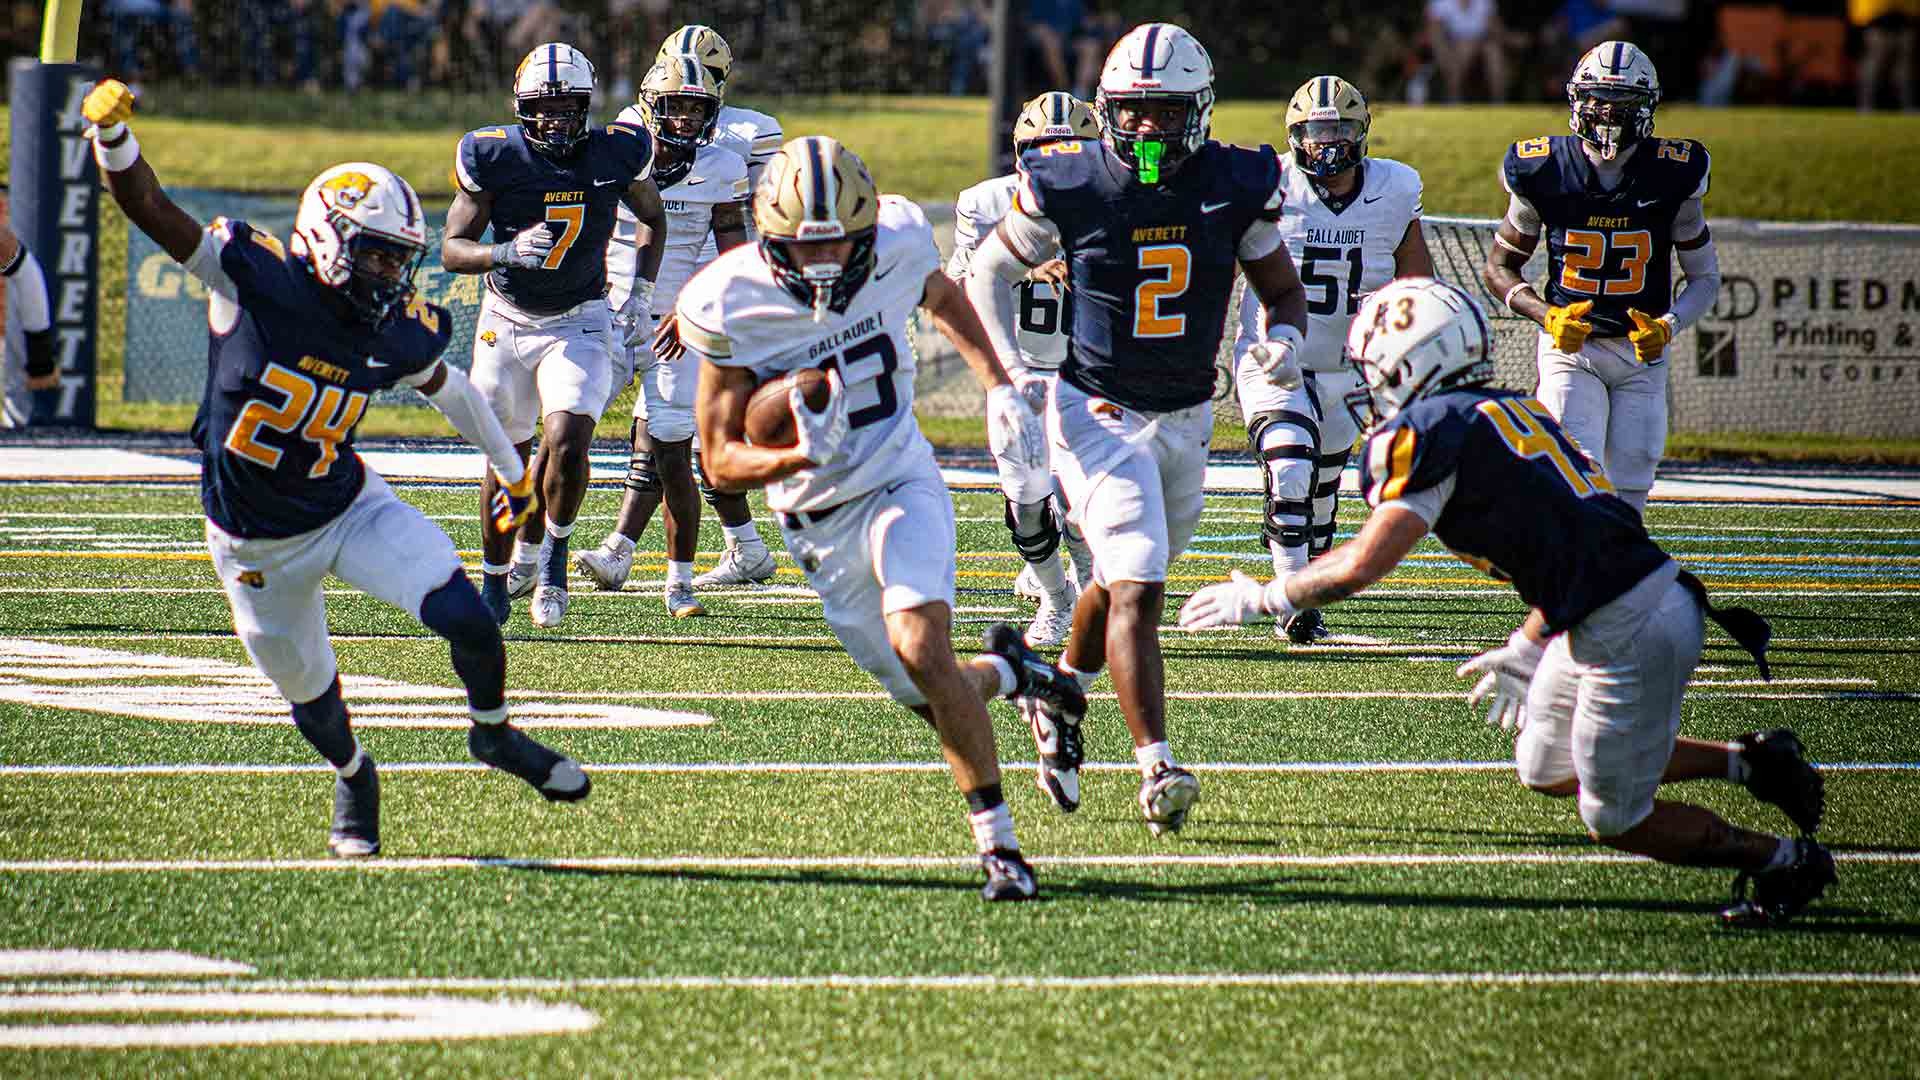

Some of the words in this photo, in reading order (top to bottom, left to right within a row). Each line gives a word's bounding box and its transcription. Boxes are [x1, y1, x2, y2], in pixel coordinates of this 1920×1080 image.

[1045, 127, 1072, 135] Riddell
[543, 191, 585, 203] AVERETT
[541, 204, 586, 270] 7
[1131, 225, 1187, 242] AVERETT
[1306, 228, 1366, 245] GALLAUDET
[1586, 215, 1629, 229] AVERETT
[56, 75, 95, 417] AVERETT
[1560, 229, 1652, 295] 23
[1132, 244, 1192, 338] 2
[1300, 246, 1363, 316] 51
[807, 311, 884, 361] GALLAUDET
[1773, 320, 1877, 352] Printing
[1895, 322, 1914, 347] &
[297, 354, 351, 384] AVERETT
[1774, 363, 1920, 382] INCORP
[224, 361, 370, 479] 24
